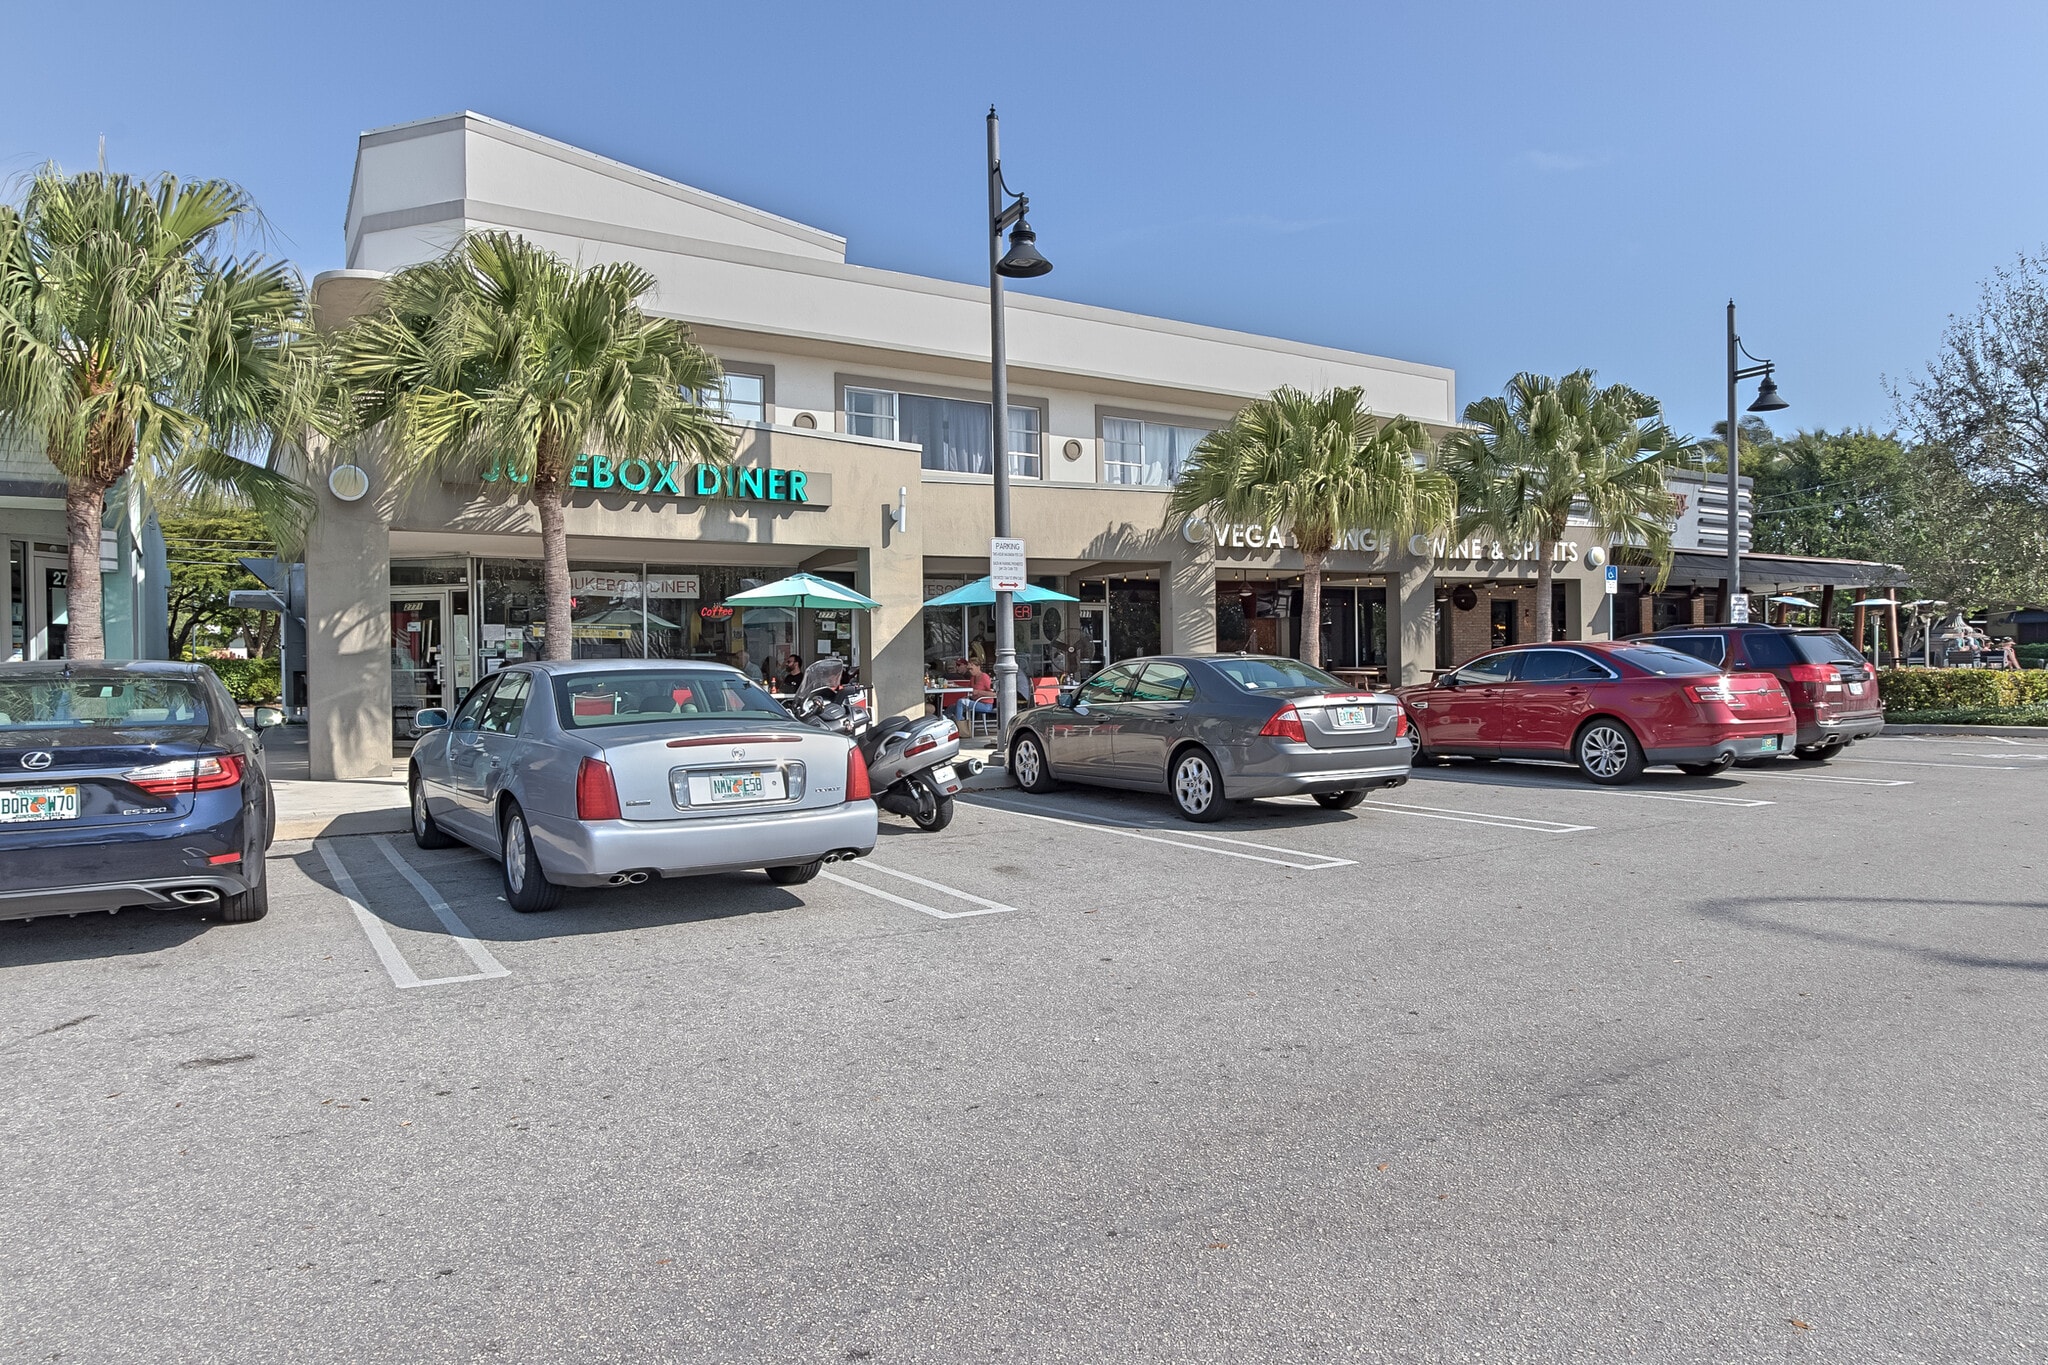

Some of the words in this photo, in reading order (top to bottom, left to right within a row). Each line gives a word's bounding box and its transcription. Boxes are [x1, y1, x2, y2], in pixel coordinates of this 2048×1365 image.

[481, 448, 679, 494] JUEBOX
[697, 462, 808, 502] DINER
[1214, 523, 1284, 549] VEGA
[995, 542, 1020, 551] PARKING
[1490, 540, 1505, 560] &
[1510, 541, 1579, 562] SPIITS
[650, 580, 697, 593] DINER
[700, 606, 733, 619] Coffee
[1, 797, 29, 814] BQR
